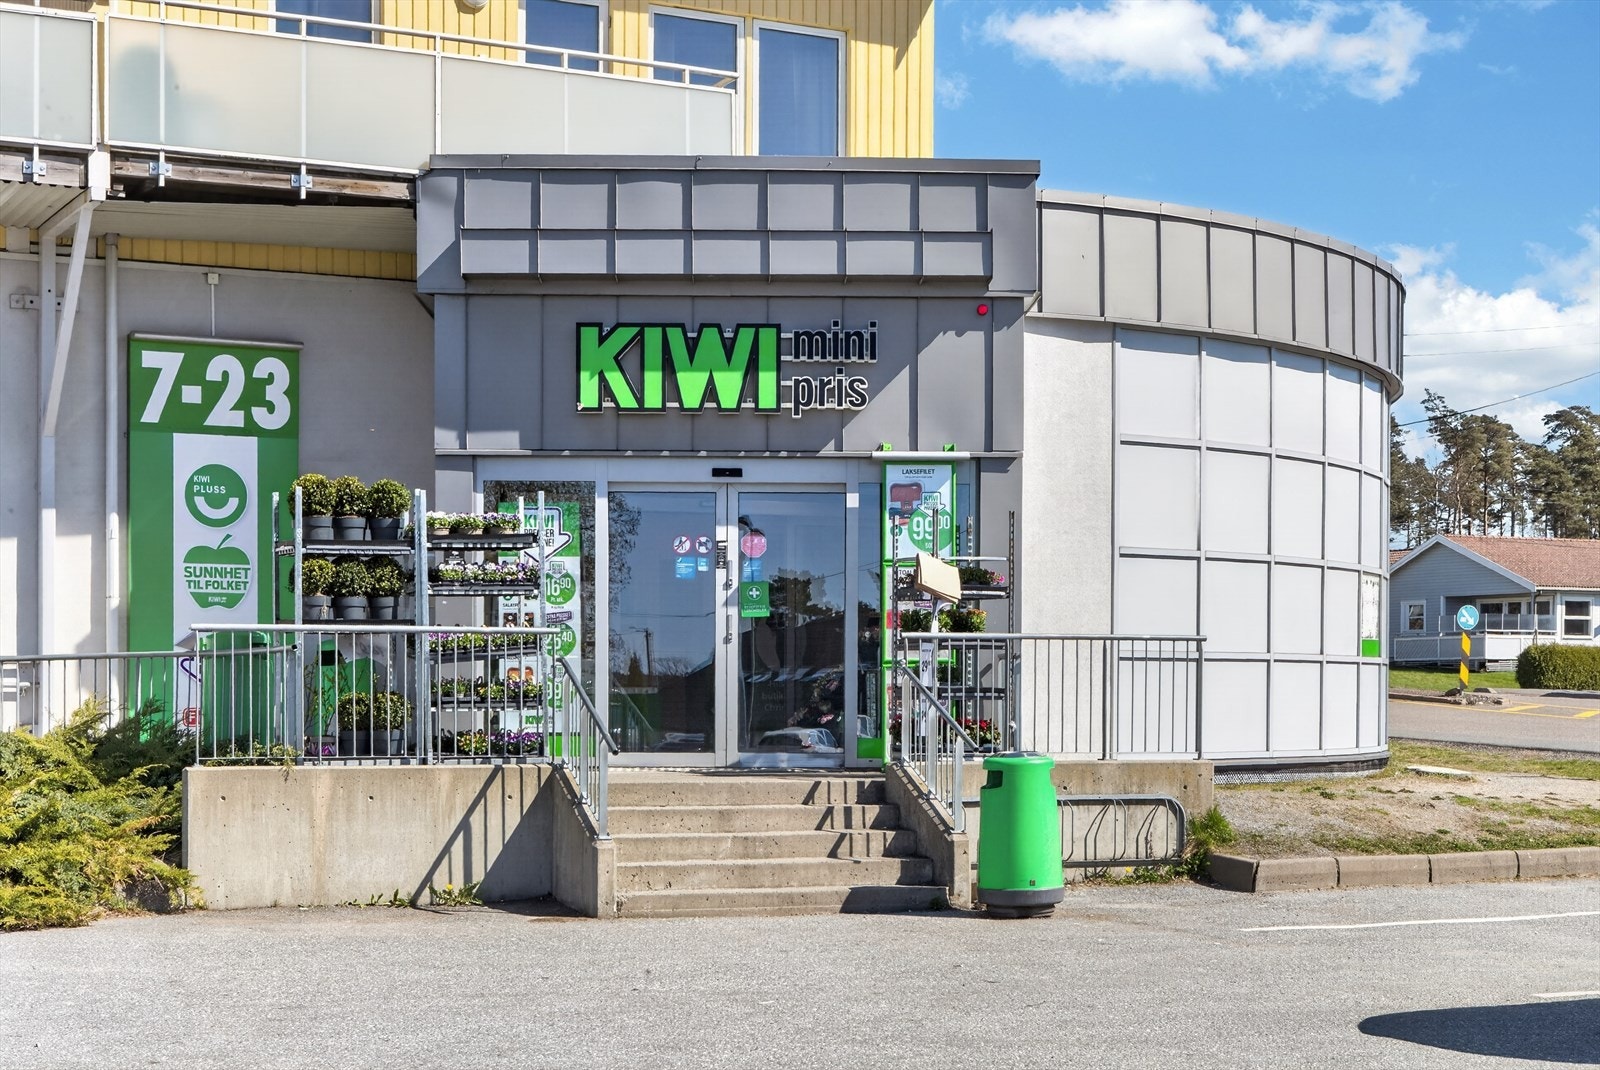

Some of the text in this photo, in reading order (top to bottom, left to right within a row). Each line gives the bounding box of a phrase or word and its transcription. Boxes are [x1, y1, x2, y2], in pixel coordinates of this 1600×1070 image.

[576, 319, 878, 414] KIWI mini
[140, 350, 291, 430] 7-23
[792, 367, 869, 418] pris
[193, 475, 210, 483] KIWI
[193, 485, 226, 494] PLUSS
[184, 566, 251, 579] SUNNHET
[186, 579, 249, 591] TIL FOLKET
